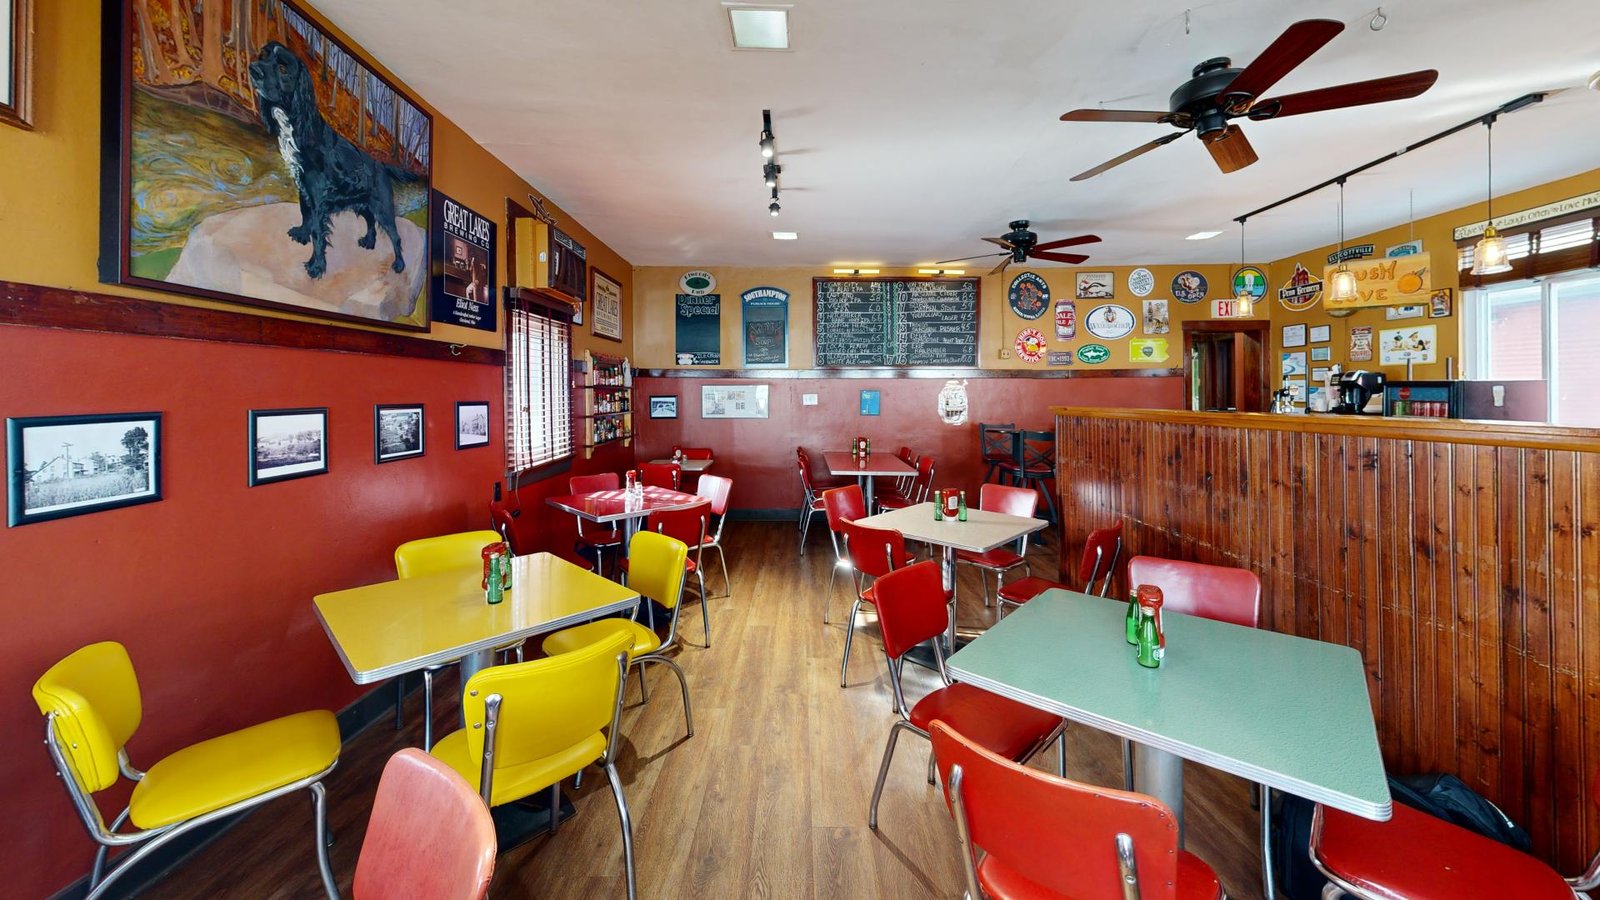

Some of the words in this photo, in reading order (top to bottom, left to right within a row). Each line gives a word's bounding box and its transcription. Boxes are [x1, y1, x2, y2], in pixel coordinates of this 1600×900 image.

[444, 200, 468, 231] GREAT
[469, 213, 490, 242] LAKES
[444, 222, 478, 244] BREWING
[1328, 246, 1372, 262] ELLICOTTVILLE
[817, 282, 822, 293] 1
[897, 282, 904, 292] 9
[1036, 277, 1047, 289] ARTS
[744, 289, 787, 302] SOUTHAMPTON
[1282, 289, 1296, 298] Penn
[1297, 284, 1320, 295] Brewery
[678, 294, 716, 305] Dinner
[897, 292, 908, 302] 10
[456, 298, 468, 310] Eliot
[468, 302, 480, 312] Ness
[680, 304, 720, 317] Special
[817, 302, 825, 312] 3
[897, 303, 905, 312] 11
[897, 313, 907, 323] 12
[817, 323, 825, 334] 5
[897, 323, 907, 333] 13
[817, 334, 825, 344] 6
[897, 333, 907, 344] 14
[817, 344, 825, 354] 7
[897, 344, 907, 354] 15
[817, 354, 824, 365] 8
[883, 355, 893, 365] 17
[896, 354, 907, 365] 16
